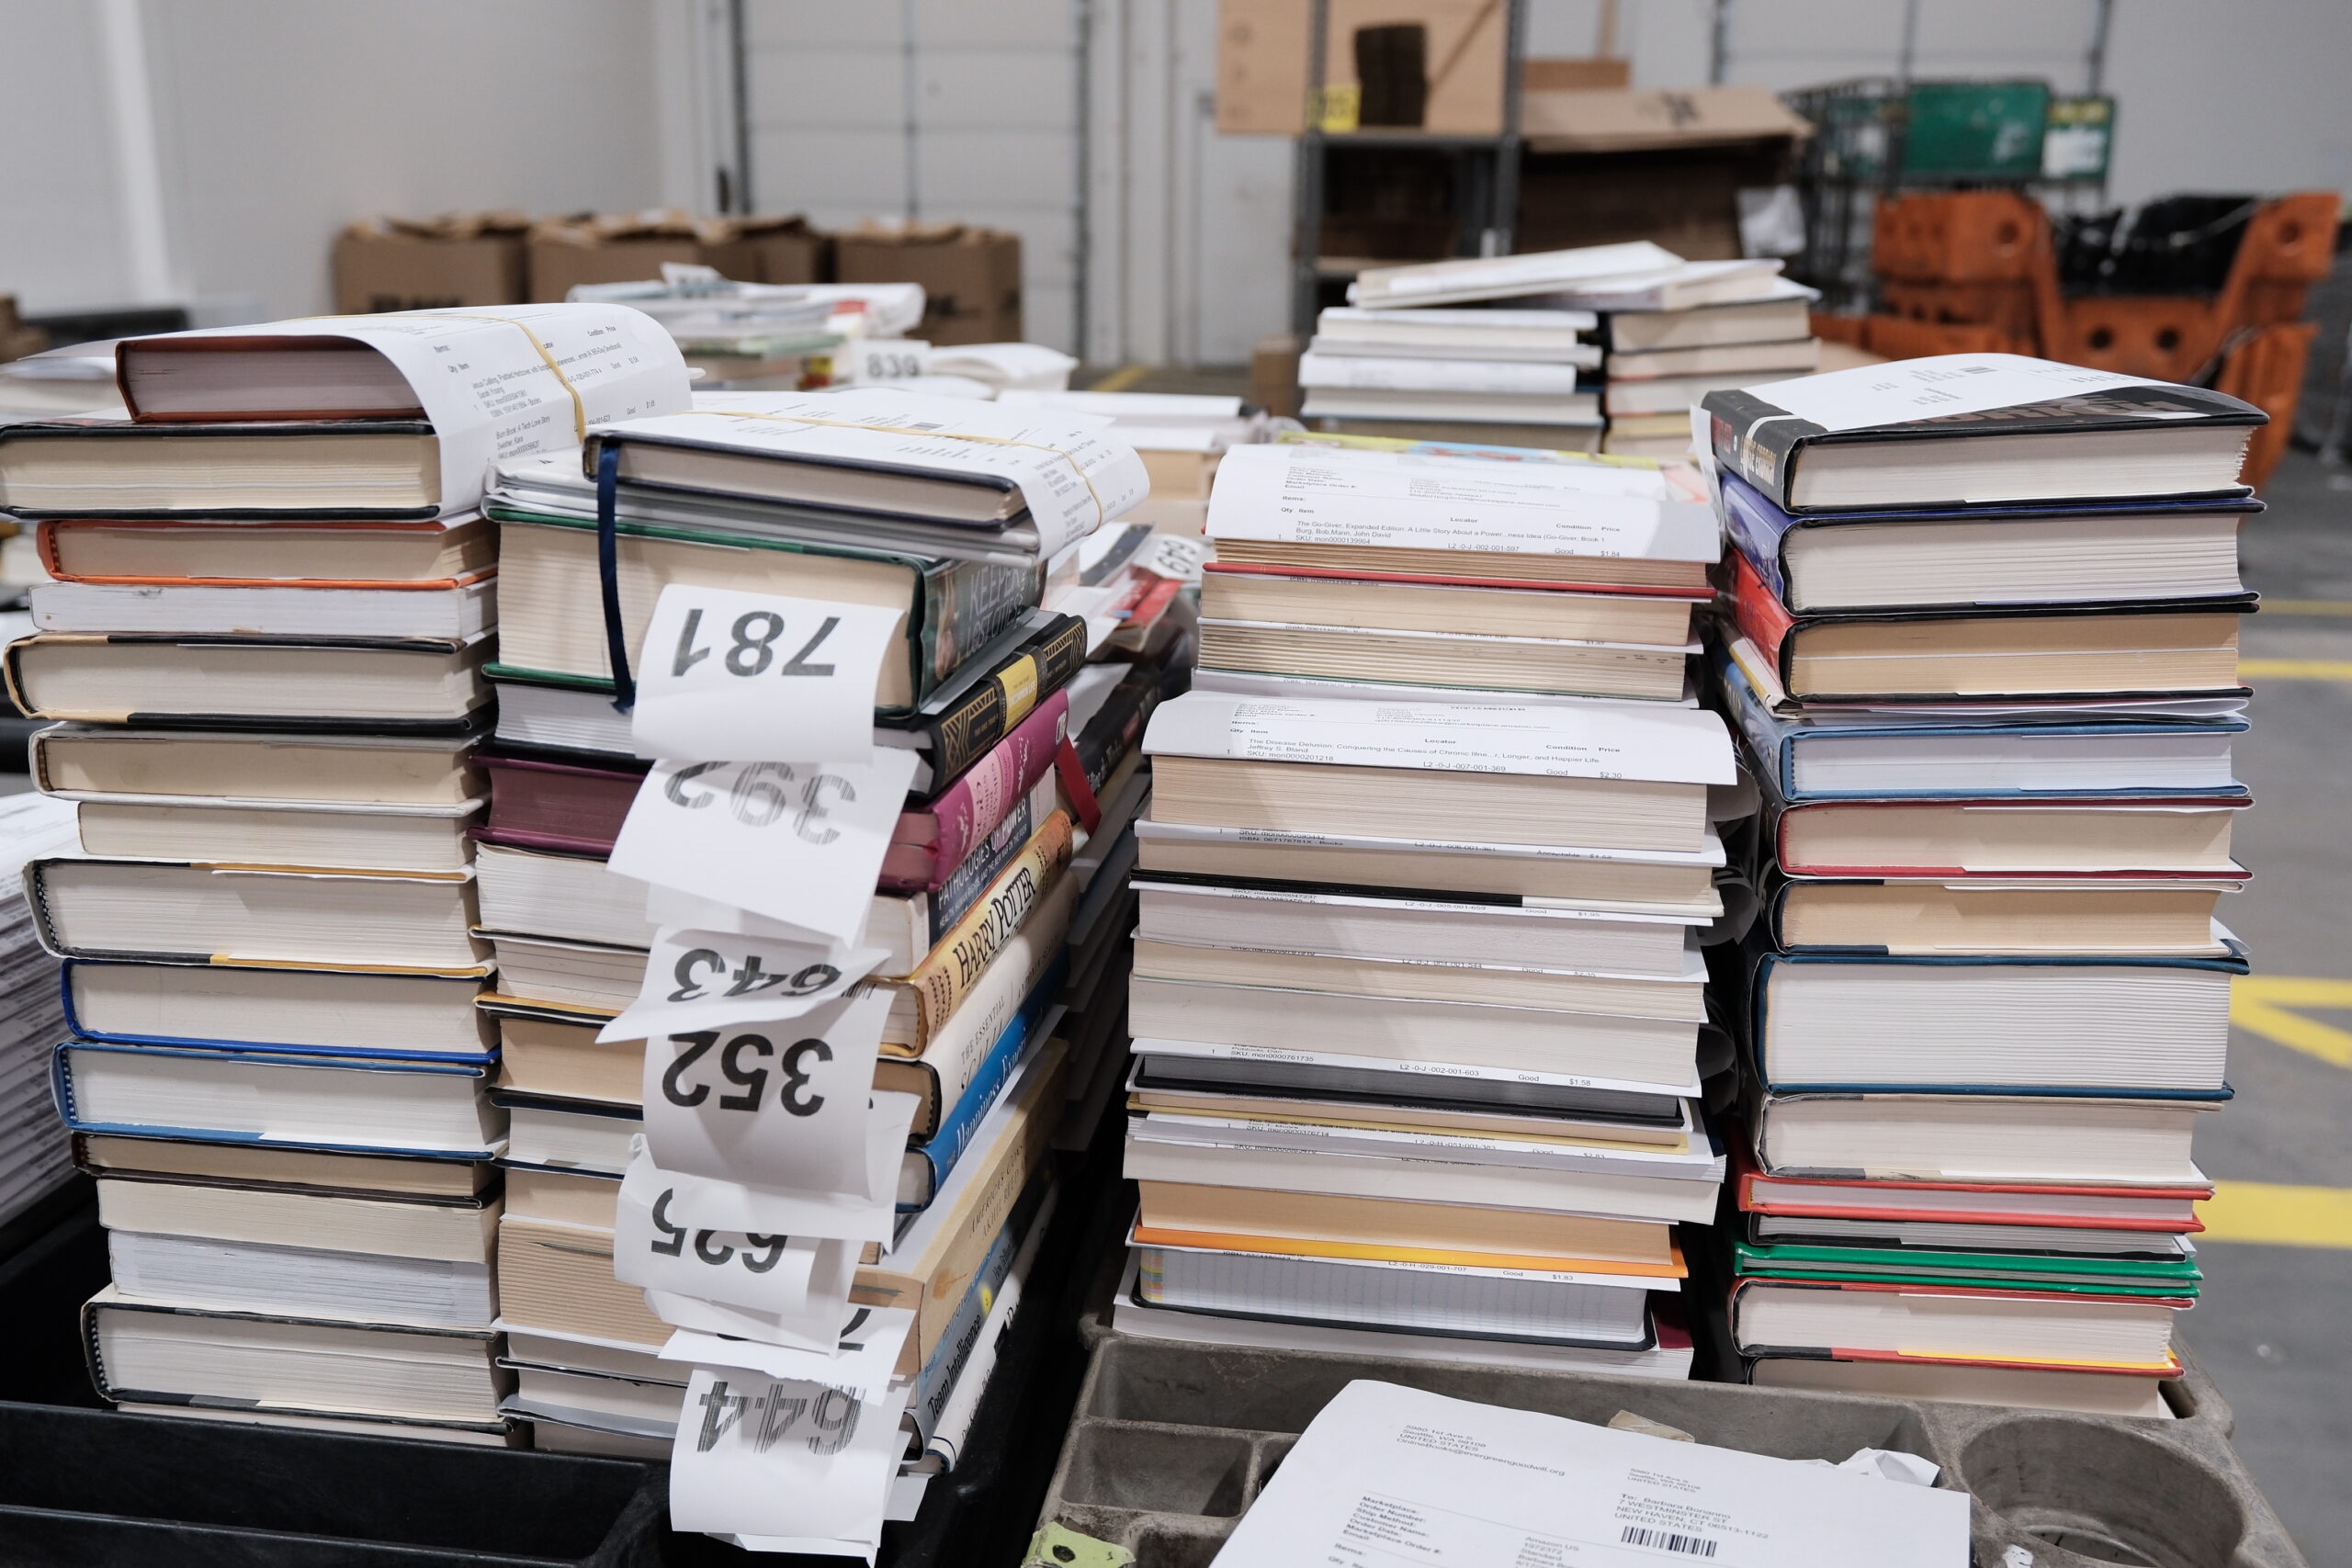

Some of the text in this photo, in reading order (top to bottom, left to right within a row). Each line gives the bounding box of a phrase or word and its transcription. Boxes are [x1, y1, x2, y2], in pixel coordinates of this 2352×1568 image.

[671, 608, 841, 677] 781
[1337, 743, 1381, 752] Conquering
[937, 838, 990, 910] PATHOLOGIES
[1001, 797, 1028, 840] POWER
[952, 909, 996, 989] HARRY
[990, 867, 1036, 942] POTTER
[667, 948, 842, 1002] 643
[961, 995, 1005, 1066] THE ESSENTIAL
[662, 1031, 833, 1117] 352
[1428, 1066, 1479, 1077] -002-001-603
[1519, 1074, 1540, 1082] Good
[1569, 1077, 1591, 1087] $1.58
[927, 1383, 950, 1422] Team
[946, 1314, 981, 1384] Intelligence
[696, 1382, 862, 1456] 644
[1399, 1433, 1479, 1451] UNITED STATES
[1403, 1429, 1434, 1438] Seattle,
[1627, 1476, 1696, 1493] UNITED STATES
[1360, 1502, 1426, 1523] Order Number:
[1363, 1495, 1420, 1515] Marketplace:
[1628, 1500, 1711, 1520] WESTMINSTER
[1644, 1497, 1683, 1510] Barbara
[1686, 1506, 1731, 1519] Bonanno
[1350, 1518, 1402, 1537] Order Date:
[1353, 1513, 1430, 1538] Customer Name:
[1357, 1507, 1417, 1528] Ship Method:
[1615, 1512, 1702, 1532] UNITED STATES
[1617, 1506, 1646, 1516] NEW
[1650, 1511, 1684, 1522] HAVEN,
[1708, 1522, 1769, 1539] 06513-1122
[1347, 1524, 1430, 1551] Marketplace Order
[1525, 1536, 1563, 1548] Amazon
[1335, 1543, 1367, 1557] Items:
[1521, 1548, 1563, 1561] Standard
